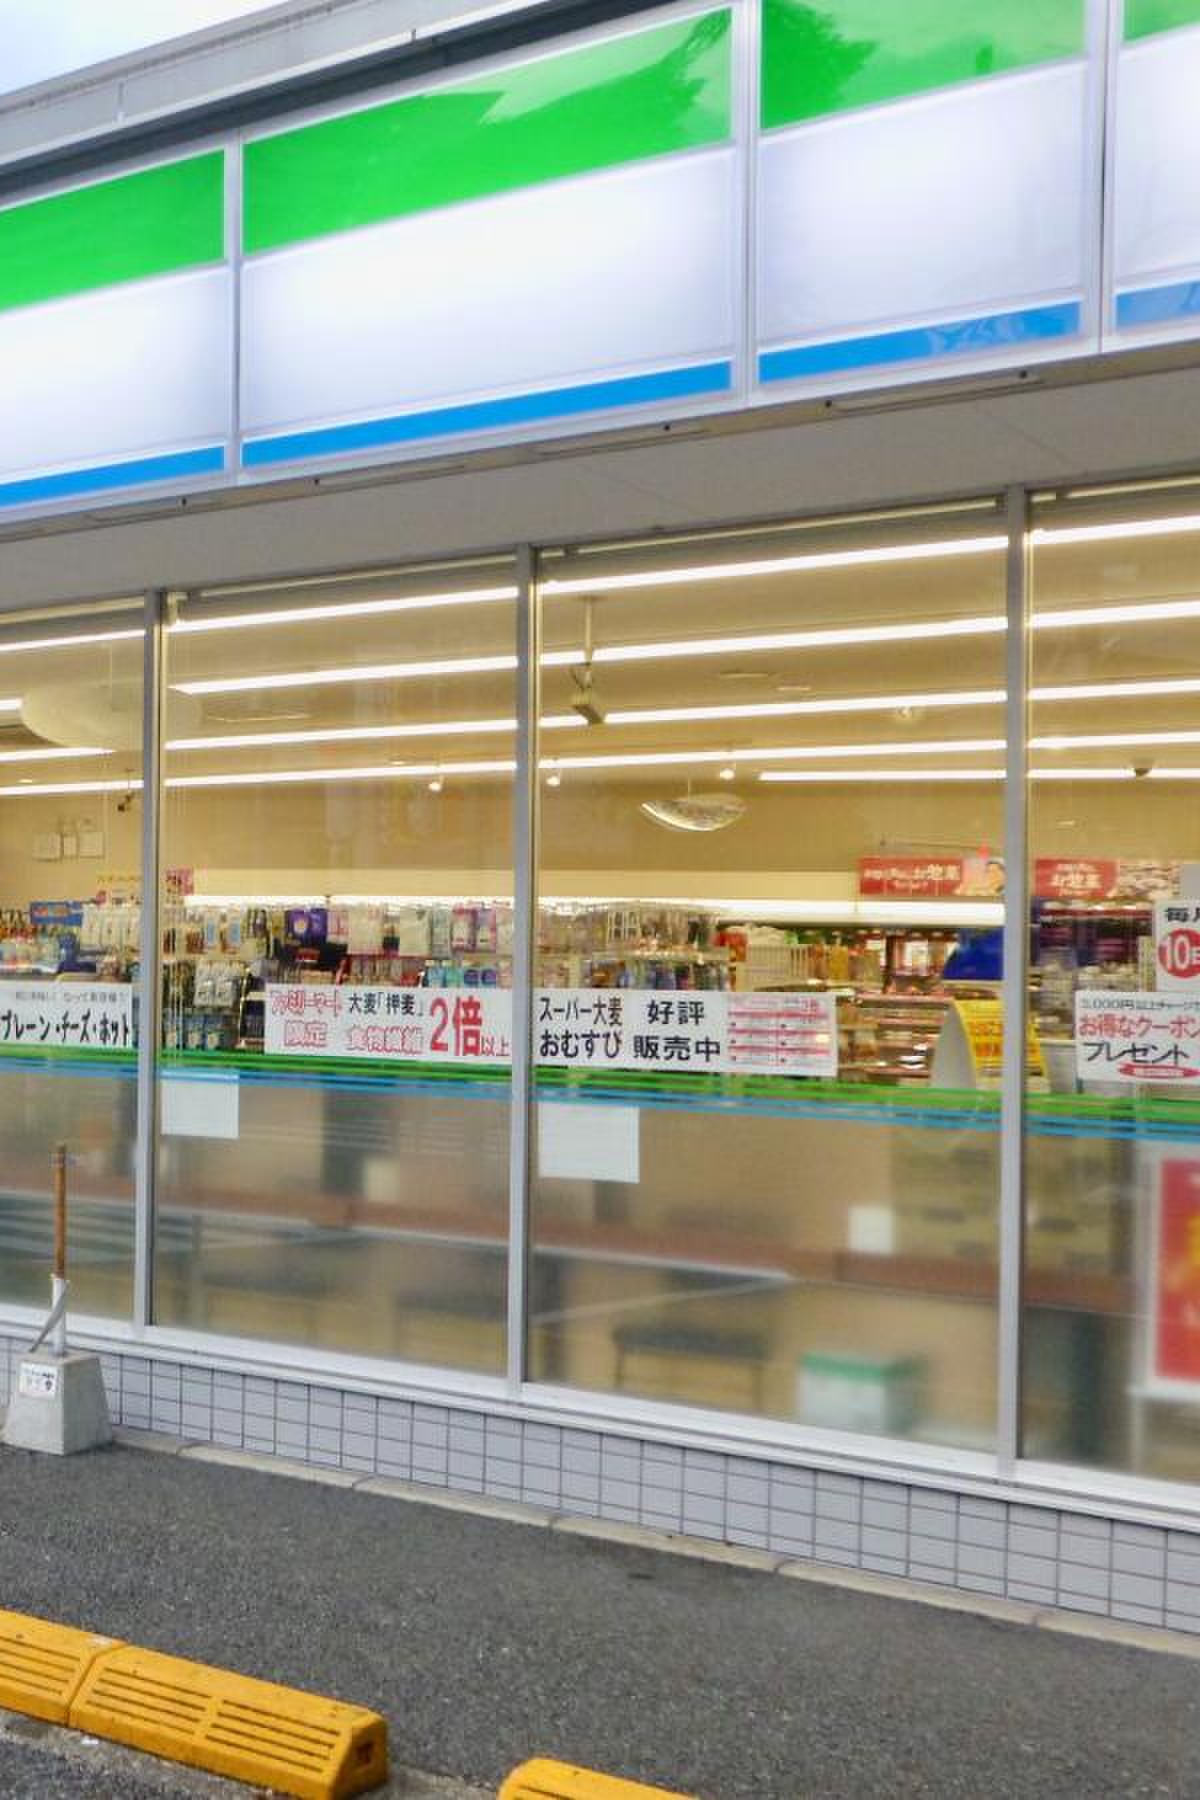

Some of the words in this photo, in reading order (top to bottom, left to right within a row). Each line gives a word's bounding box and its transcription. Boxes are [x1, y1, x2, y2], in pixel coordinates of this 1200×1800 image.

[539, 996, 623, 1026] スーパー大麦
[646, 1000, 704, 1025] 好評
[539, 1029, 623, 1058] おむすび
[633, 1035, 720, 1062] 販売中
